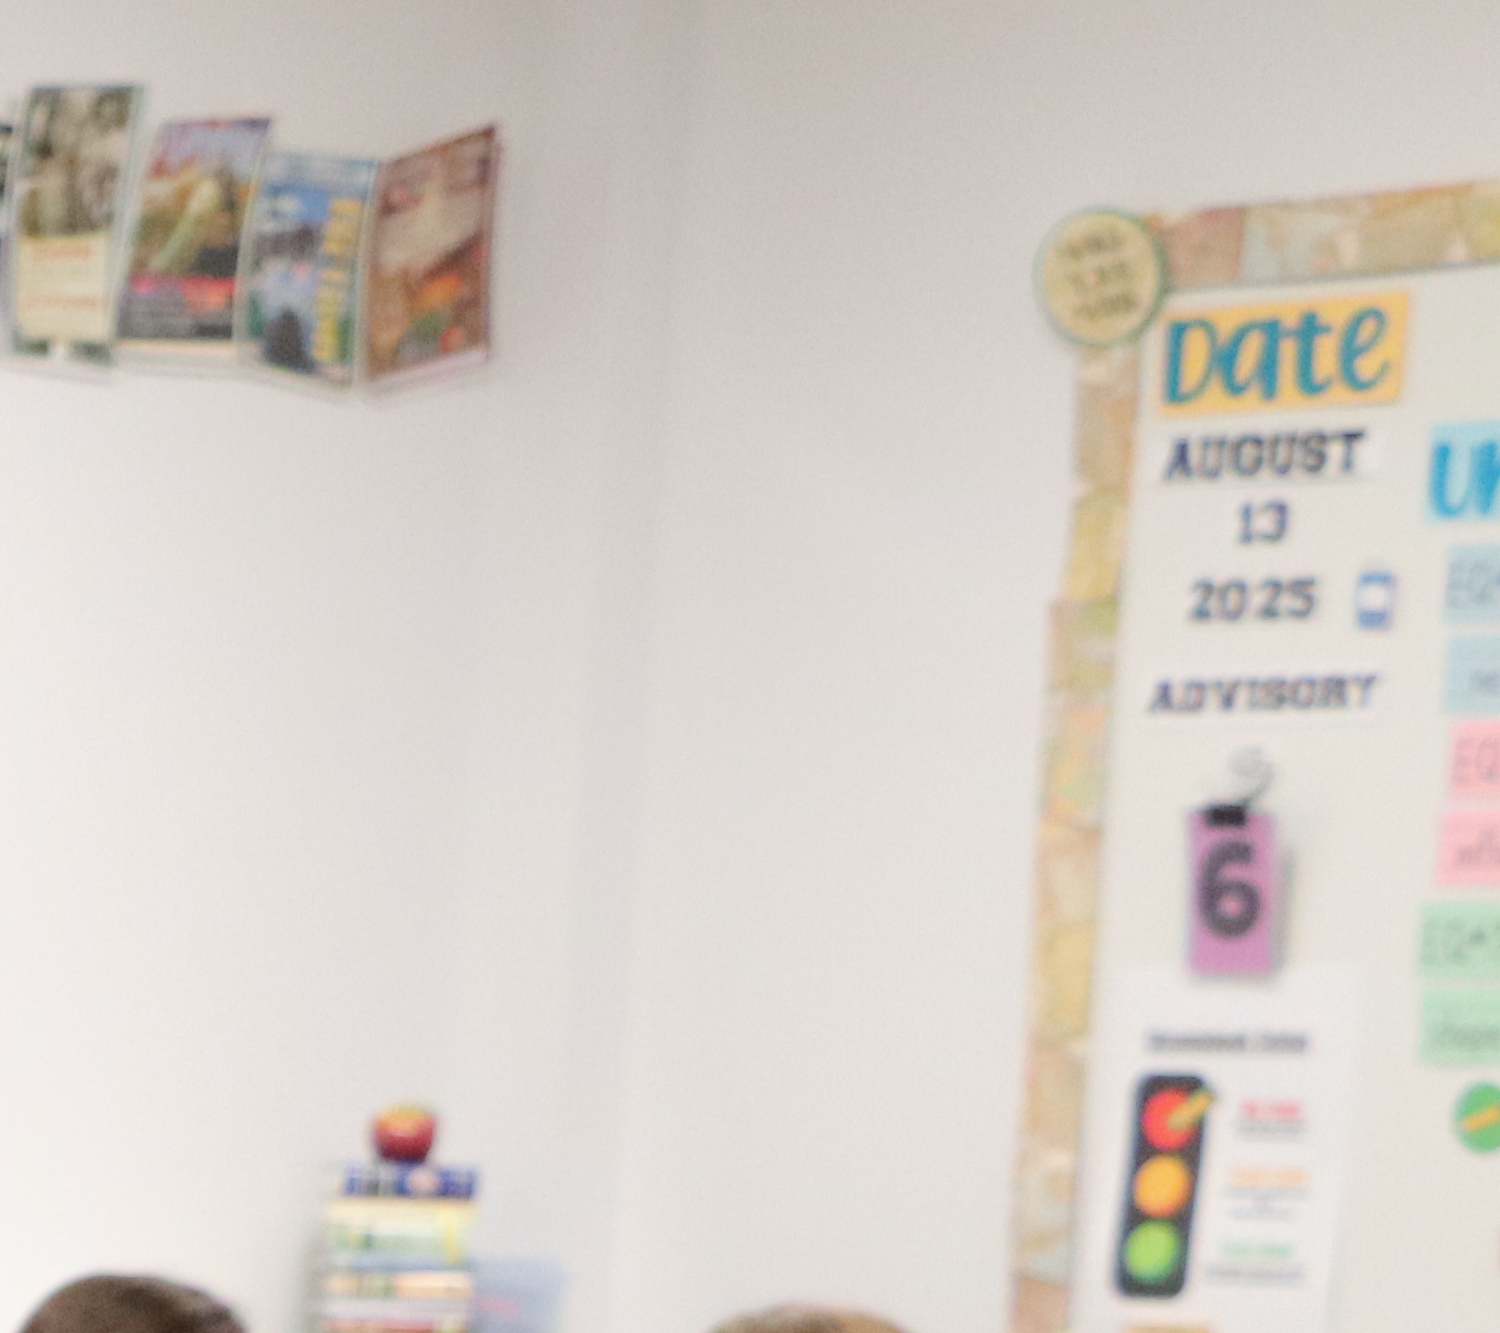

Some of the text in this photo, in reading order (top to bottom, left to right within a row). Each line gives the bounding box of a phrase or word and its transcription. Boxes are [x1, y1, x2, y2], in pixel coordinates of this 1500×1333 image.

[1162, 306, 1392, 406] Date
[1163, 427, 1367, 480] AUGUST
[1238, 499, 1291, 545] 13
[1189, 575, 1318, 622] 2025
[1148, 669, 1380, 714] ADVISORY
[1200, 840, 1261, 939] 6
